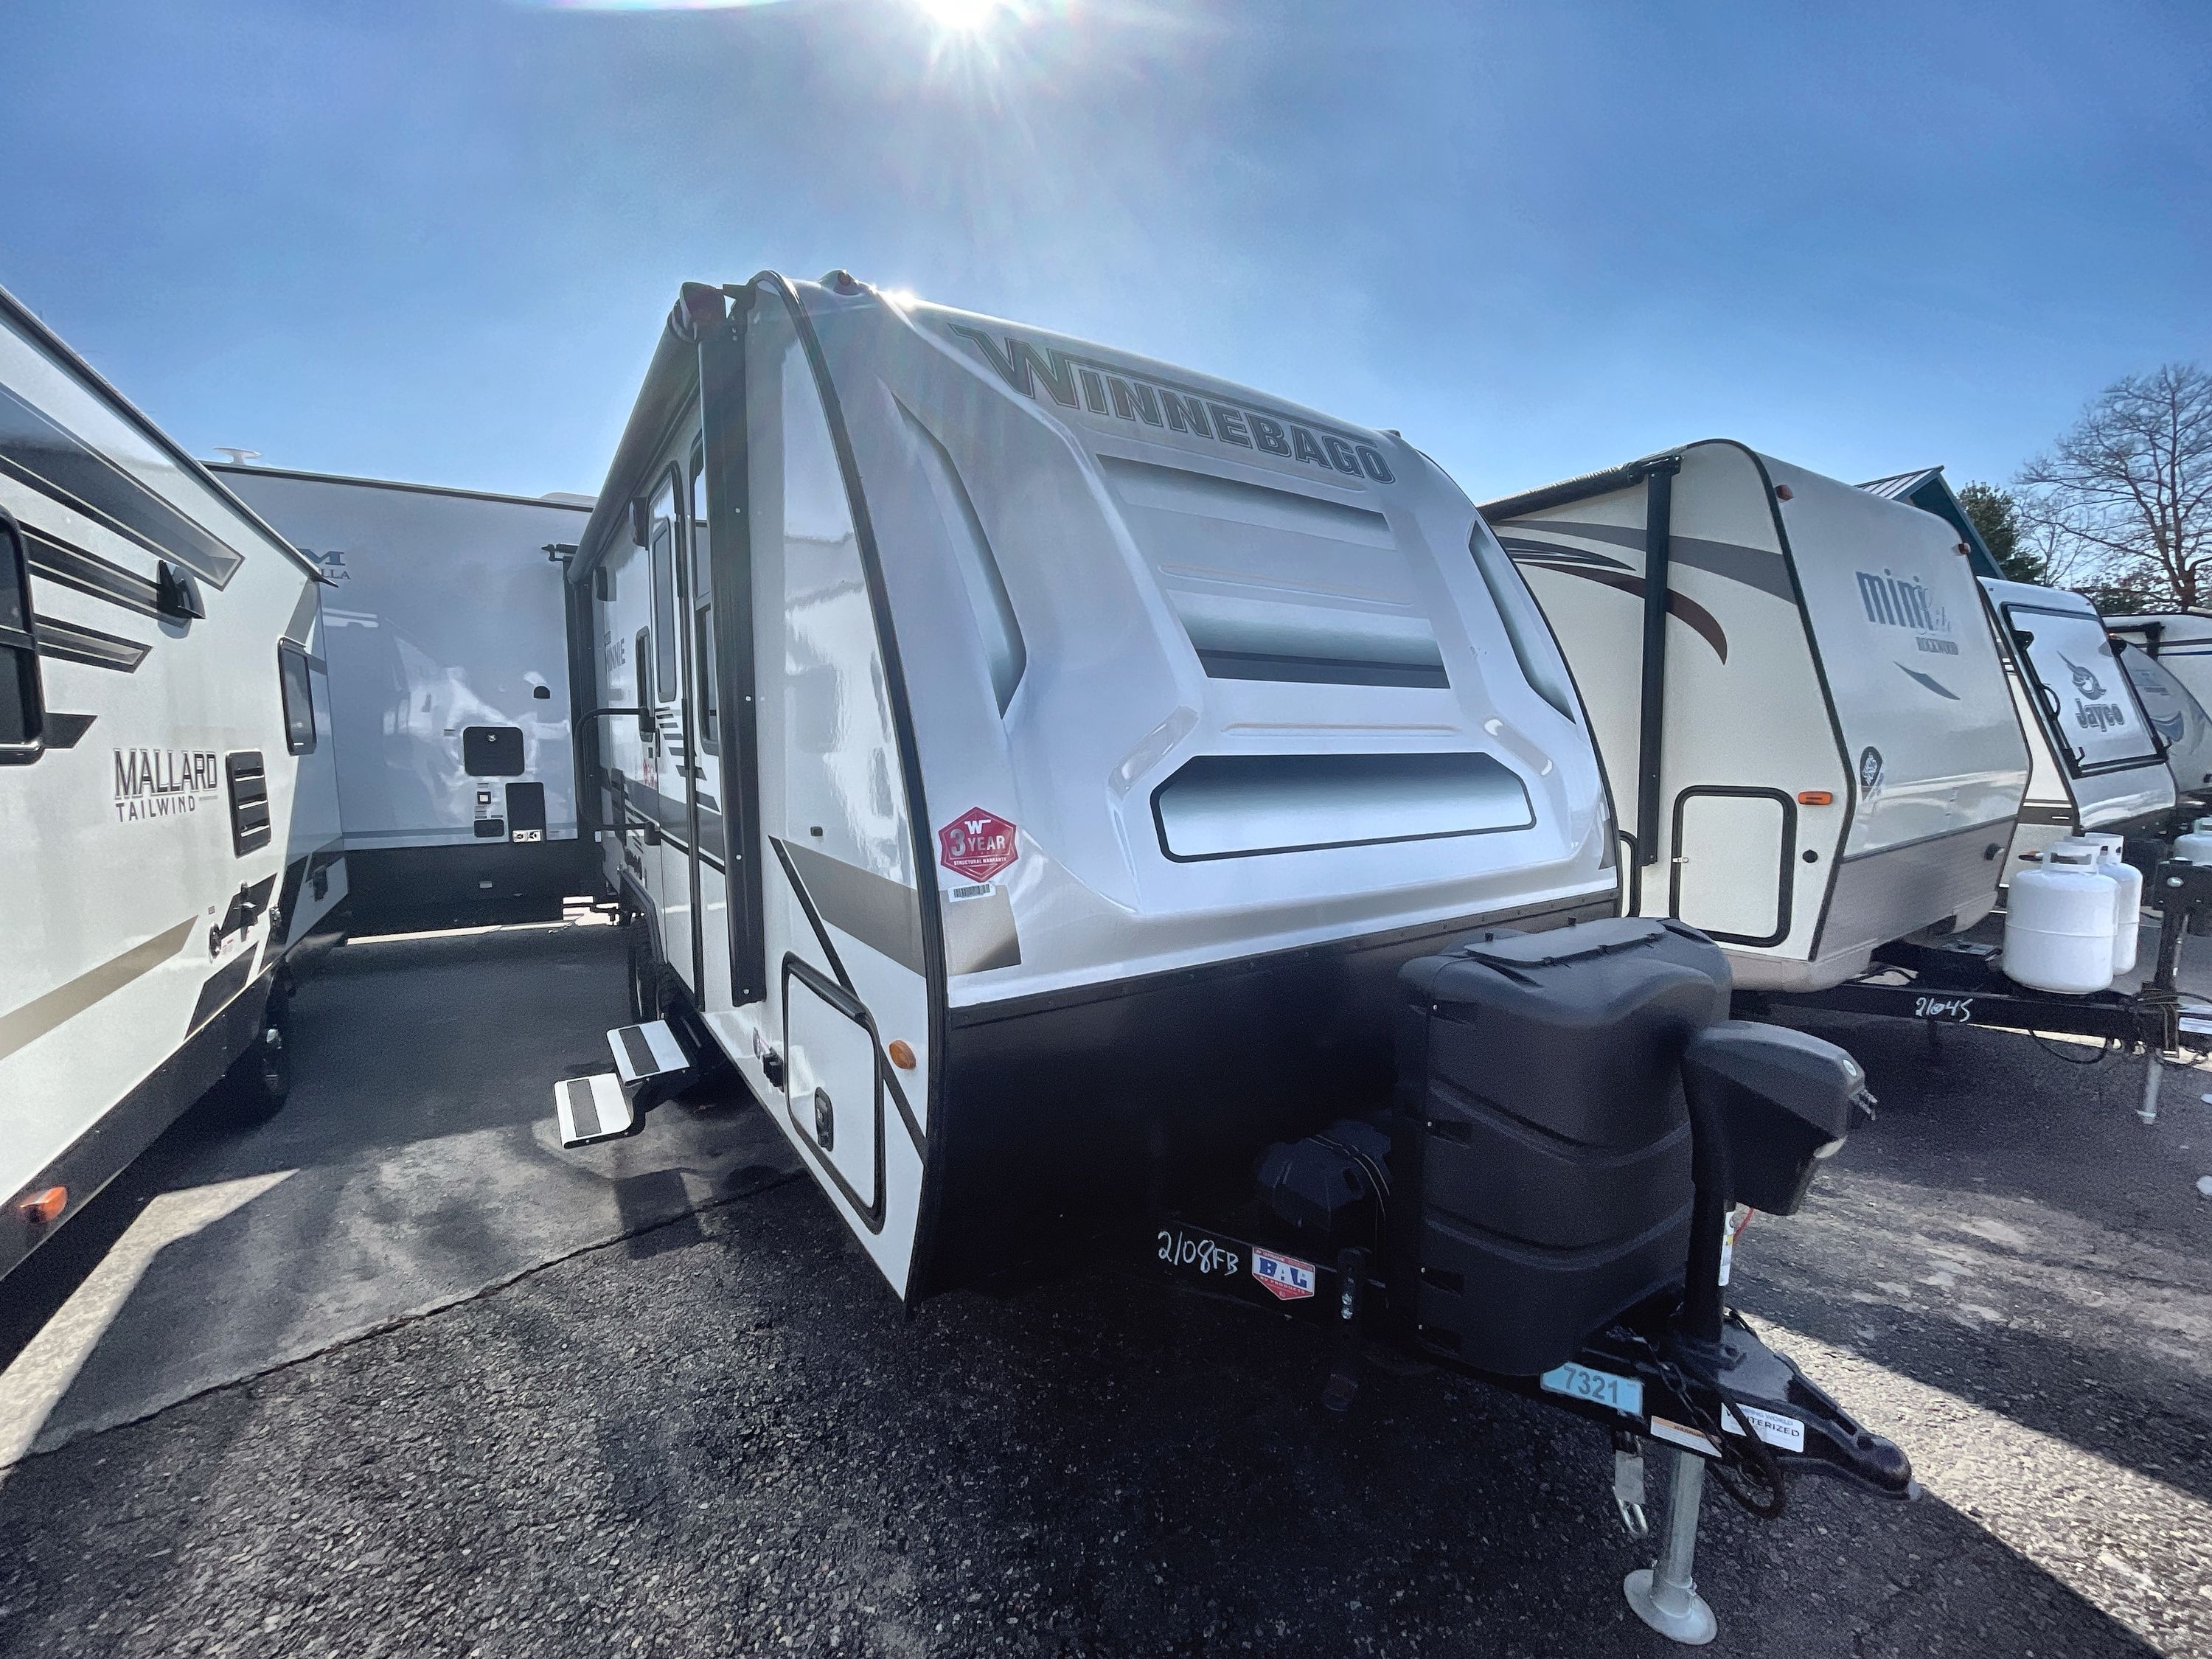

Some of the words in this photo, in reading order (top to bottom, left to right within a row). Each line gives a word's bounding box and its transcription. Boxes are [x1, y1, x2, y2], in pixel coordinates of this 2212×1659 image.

[947, 323, 1396, 484] WINNEBAGO
[1855, 568, 1934, 630] mini
[2075, 698, 2124, 732] Jayco
[113, 748, 218, 800] MALLARD
[115, 795, 196, 823] TAILWIND
[950, 828, 966, 857] 3
[968, 835, 1006, 851] YEAR
[1158, 1230, 1239, 1276] 2108FB
[1259, 1257, 1307, 1289] BAL
[1270, 1279, 1306, 1294] PRODUCTS
[1563, 1365, 1619, 1405] 7321
